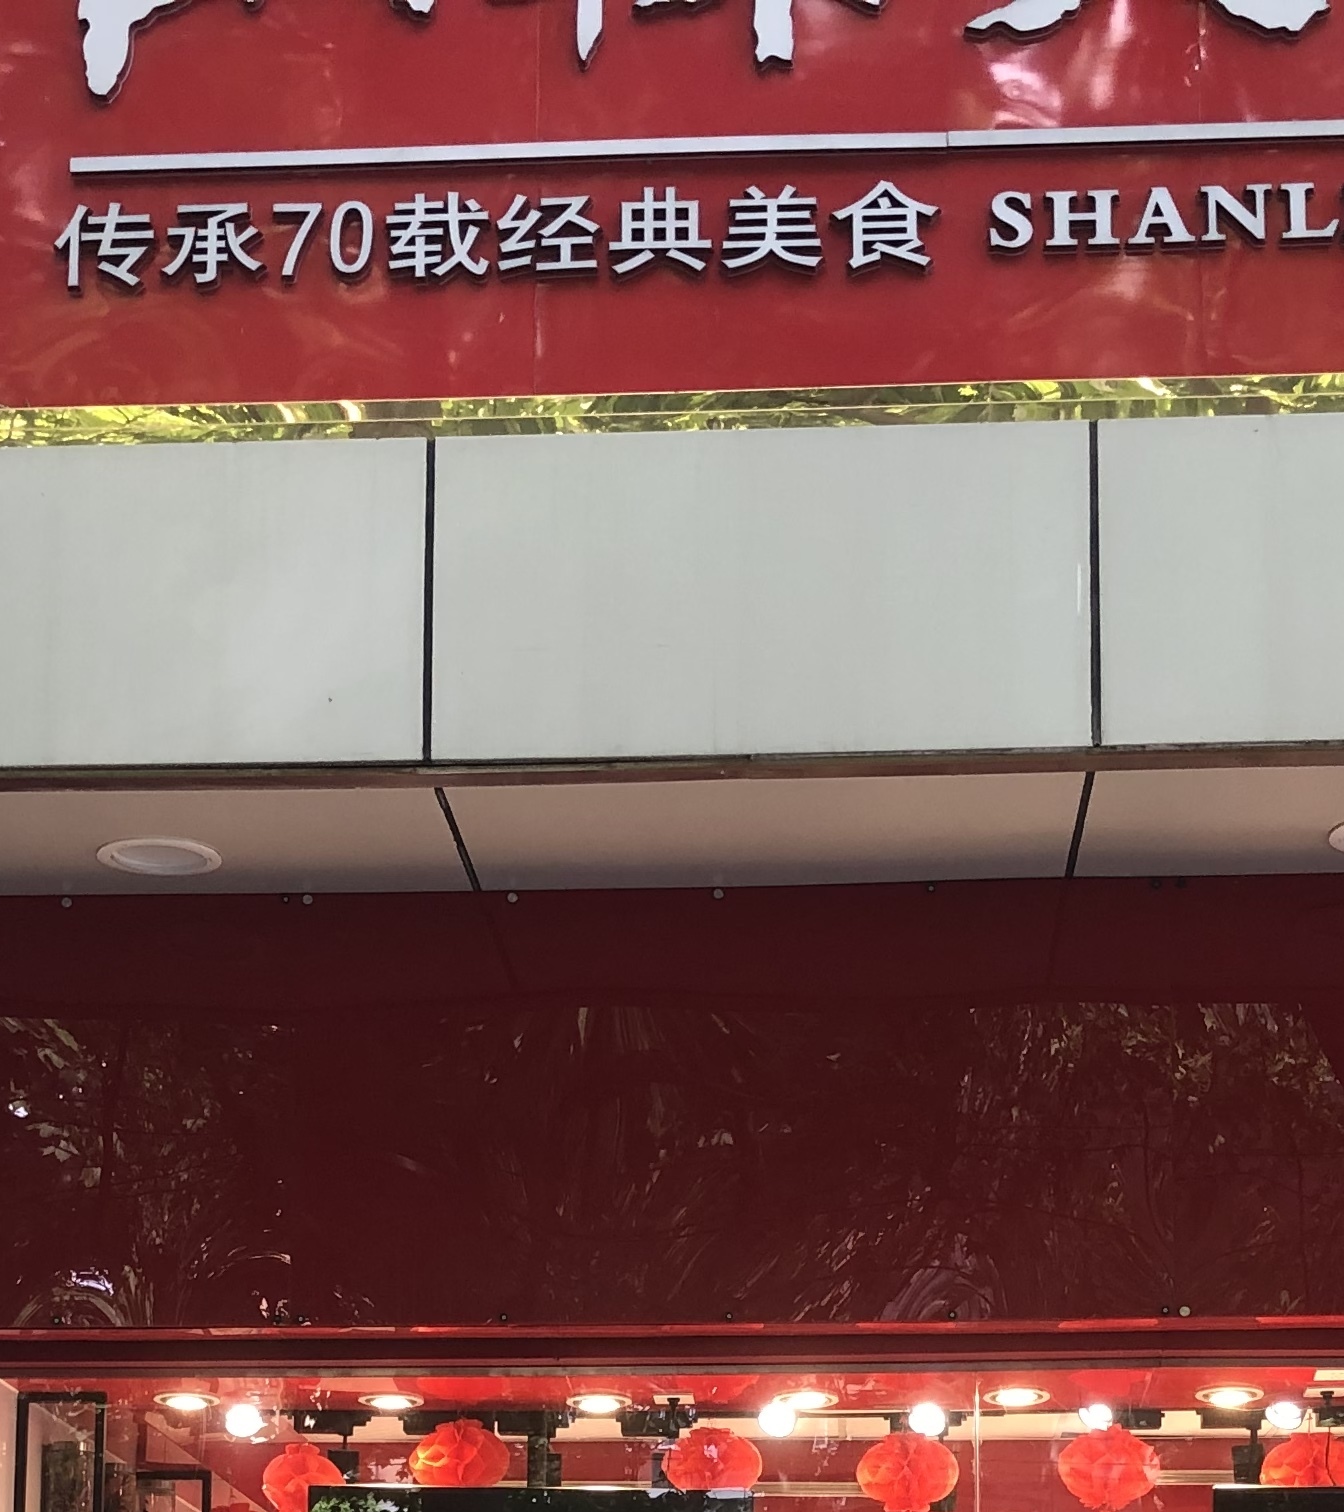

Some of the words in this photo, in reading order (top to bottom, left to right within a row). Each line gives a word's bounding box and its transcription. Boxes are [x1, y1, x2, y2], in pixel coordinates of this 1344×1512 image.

[55, 179, 939, 290] 传承70载经典美食
